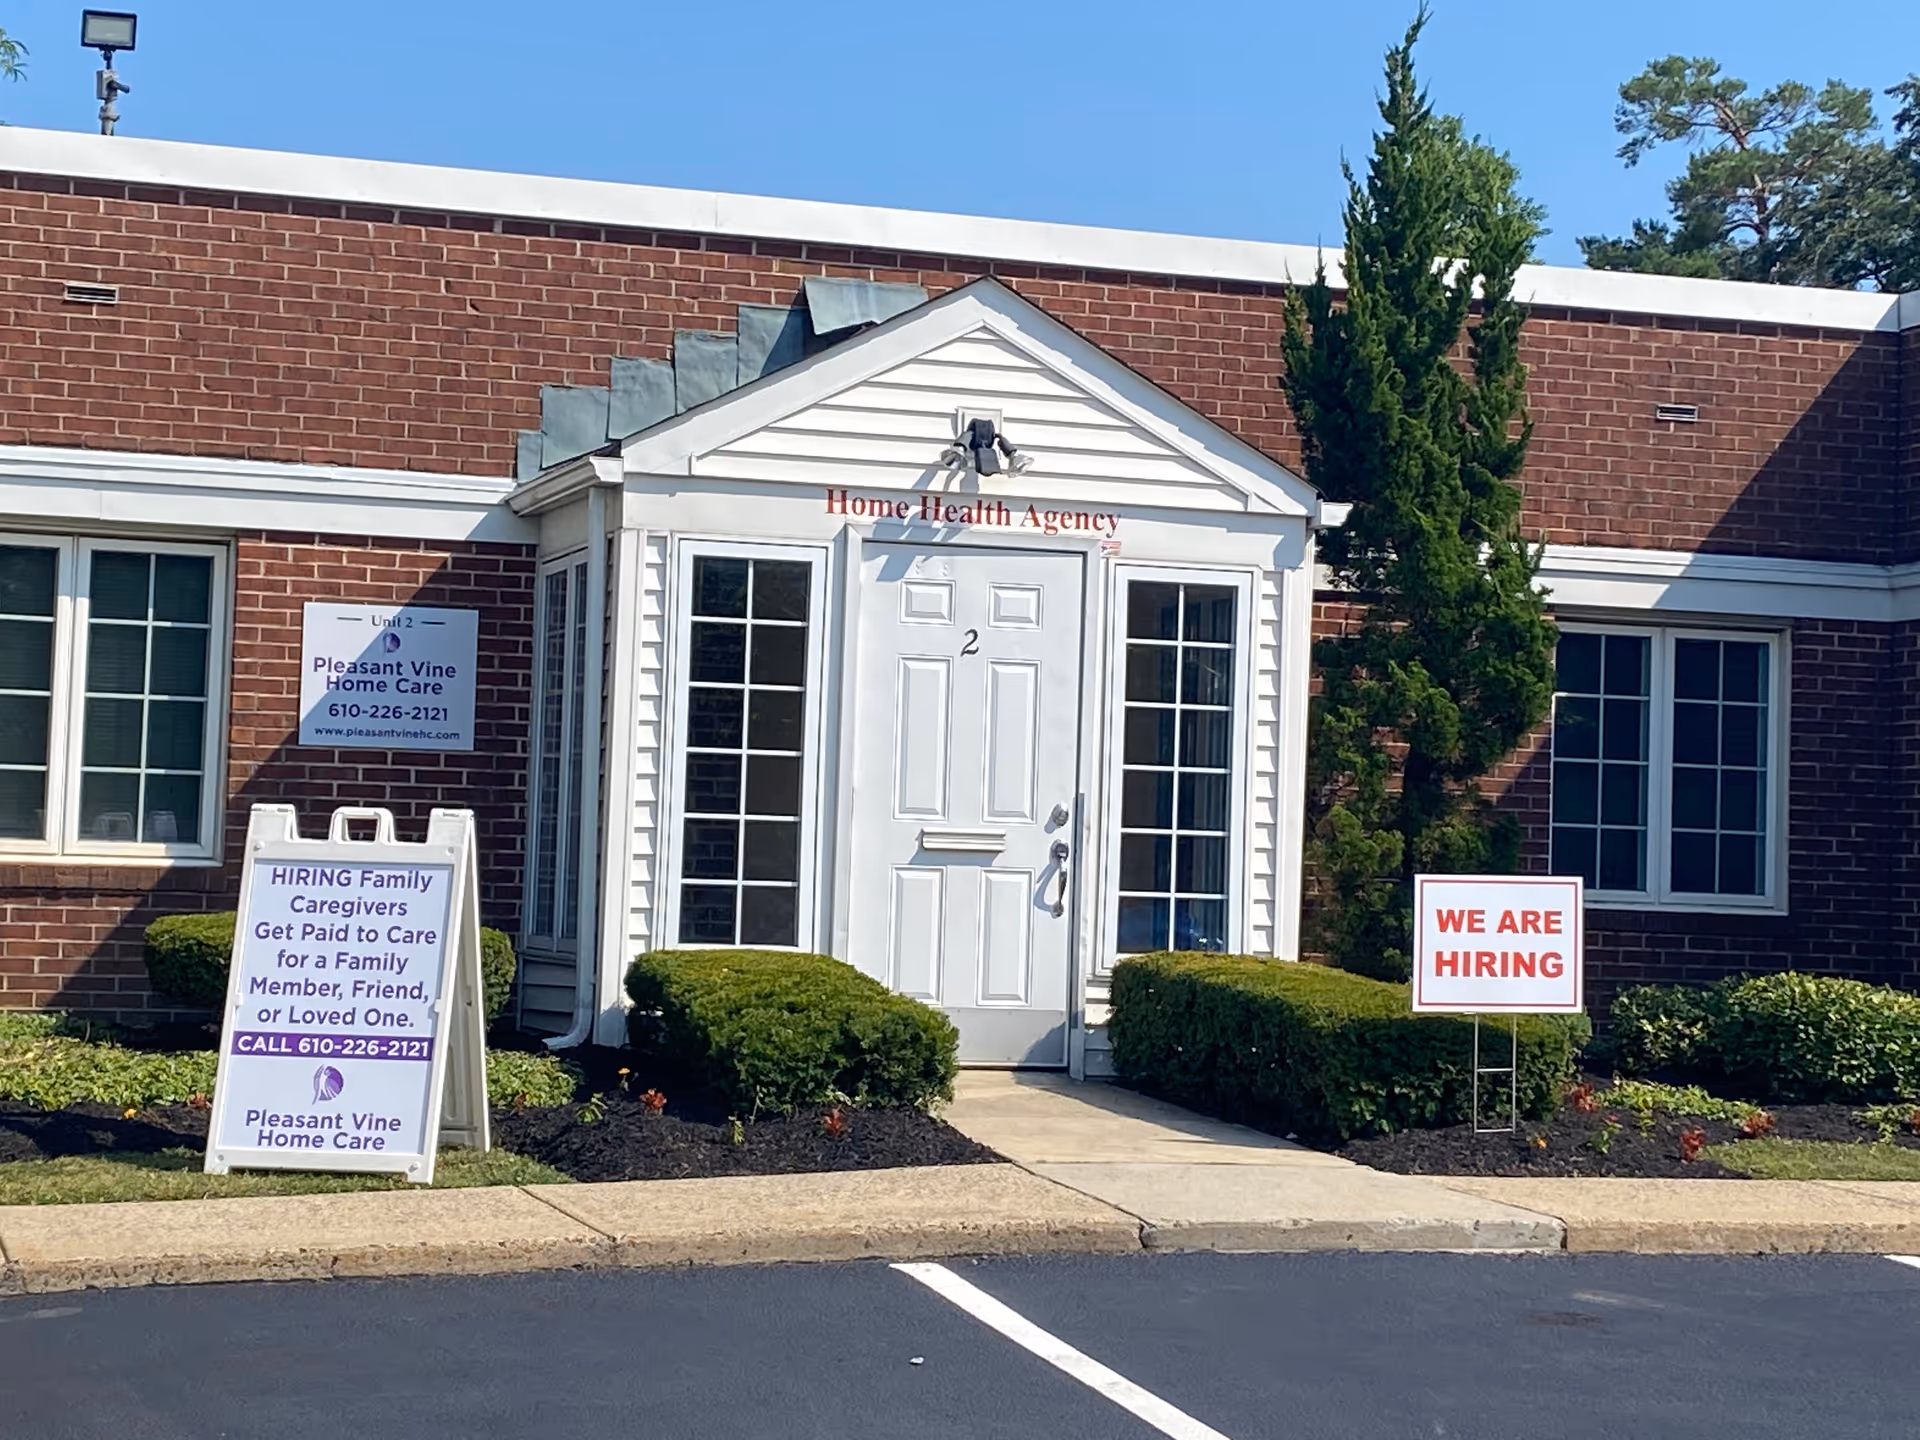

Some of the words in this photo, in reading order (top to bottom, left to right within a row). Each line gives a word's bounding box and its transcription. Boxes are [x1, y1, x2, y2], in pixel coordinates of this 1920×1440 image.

[825, 488, 909, 519] Home
[919, 494, 1011, 526] Health
[1020, 505, 1121, 538] Agency
[371, 615, 401, 628] Unit
[405, 617, 413, 628] 2
[960, 629, 979, 657] 2
[313, 657, 403, 676] Pleasant
[411, 661, 457, 678] Vine
[326, 675, 387, 692] Home
[396, 678, 443, 695] Care
[329, 703, 448, 721] 610-226-2121
[315, 727, 460, 740] www.pleasantvinehc.com
[271, 867, 351, 886] HIRING
[360, 870, 433, 892] Family
[290, 896, 408, 917] Caregivers
[1436, 909, 1485, 933] WE
[1497, 910, 1562, 934] ARE
[255, 922, 293, 940] Get
[301, 923, 349, 942] Paid
[357, 926, 378, 943] to
[387, 926, 437, 945] Care
[277, 950, 309, 968] for
[315, 955, 327, 969] a
[335, 952, 409, 975] Family
[1435, 951, 1563, 978] HIRING
[249, 977, 343, 1000] Member,
[352, 980, 429, 1003] Friend,
[257, 1008, 281, 1023] or
[289, 1006, 356, 1025] Loved
[364, 1009, 414, 1027] One.
[237, 1036, 292, 1053] CALL
[299, 1038, 428, 1057] 610-226-2121
[245, 1110, 343, 1130] Pleasant
[352, 1113, 402, 1131] Vine
[257, 1130, 324, 1148] Home
[333, 1132, 385, 1150] Care
